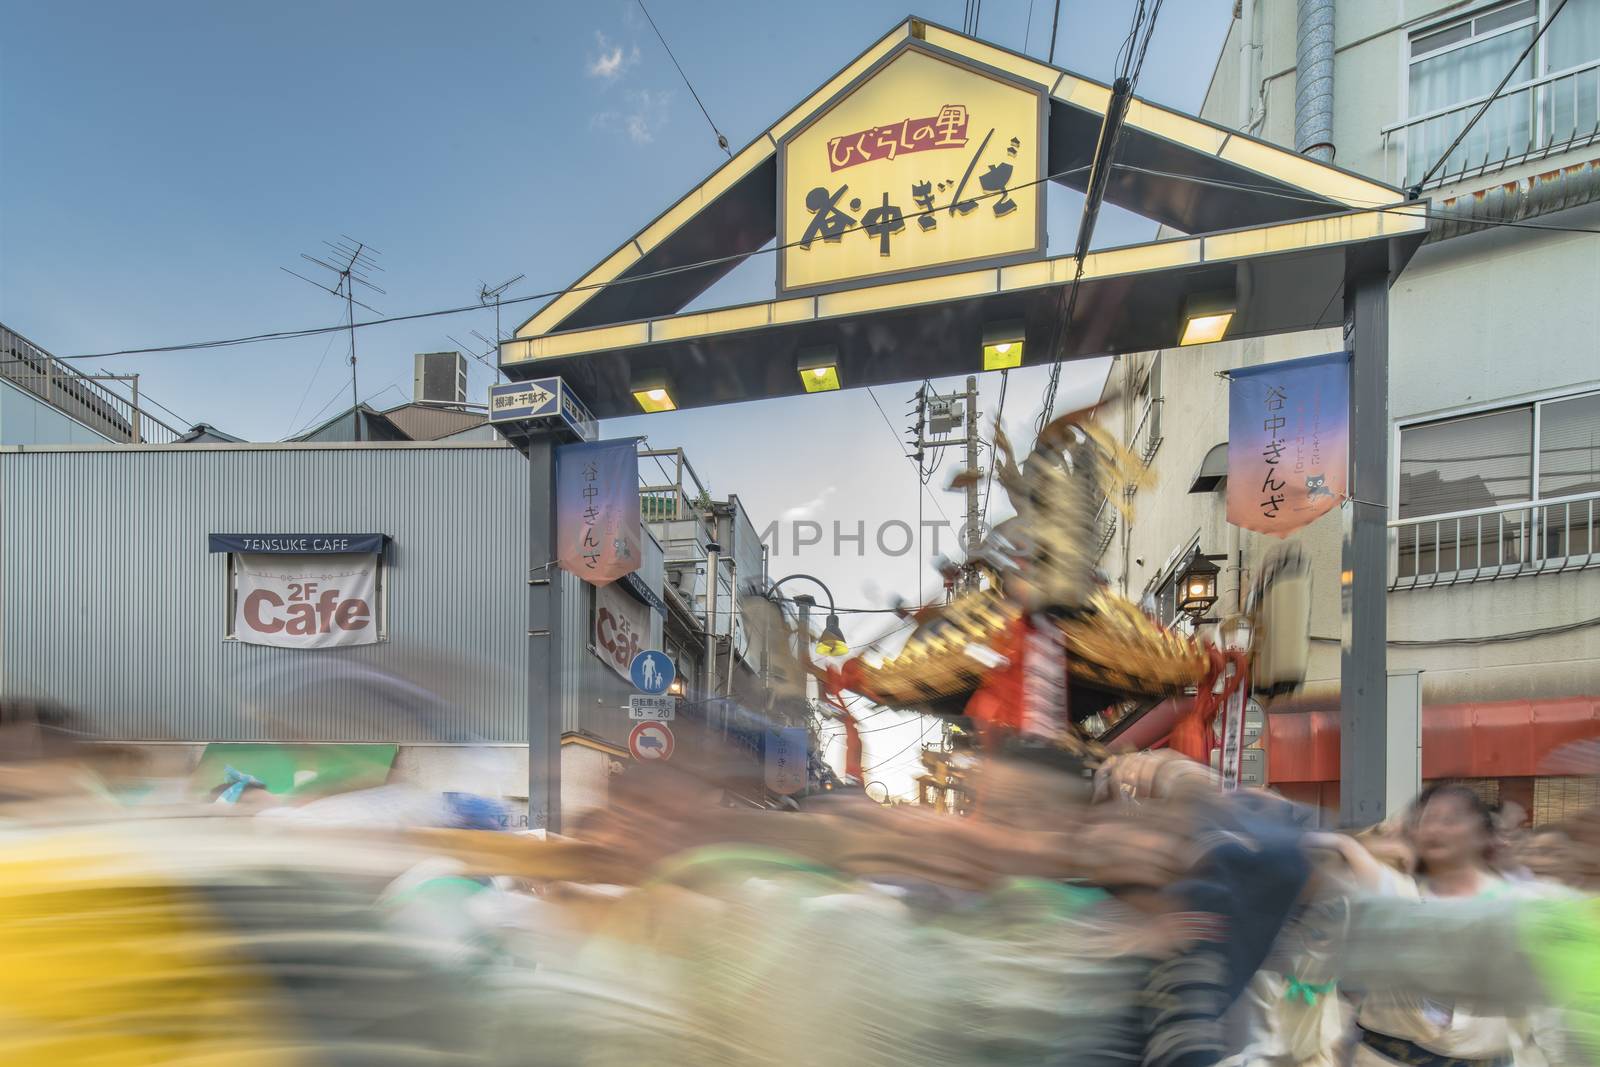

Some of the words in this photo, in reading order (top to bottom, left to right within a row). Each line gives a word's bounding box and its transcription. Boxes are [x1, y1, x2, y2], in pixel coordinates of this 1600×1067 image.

[830, 104, 969, 166] ひぐらしの里
[800, 128, 1020, 257] 谷中ぎんざ
[1260, 385, 1288, 518] 谷中ぎんざ
[313, 539, 349, 551] CAFE
[243, 588, 371, 636] Cafe
[287, 583, 319, 601] 2F
[634, 707, 643, 717] 15
[657, 709, 670, 718] 20
